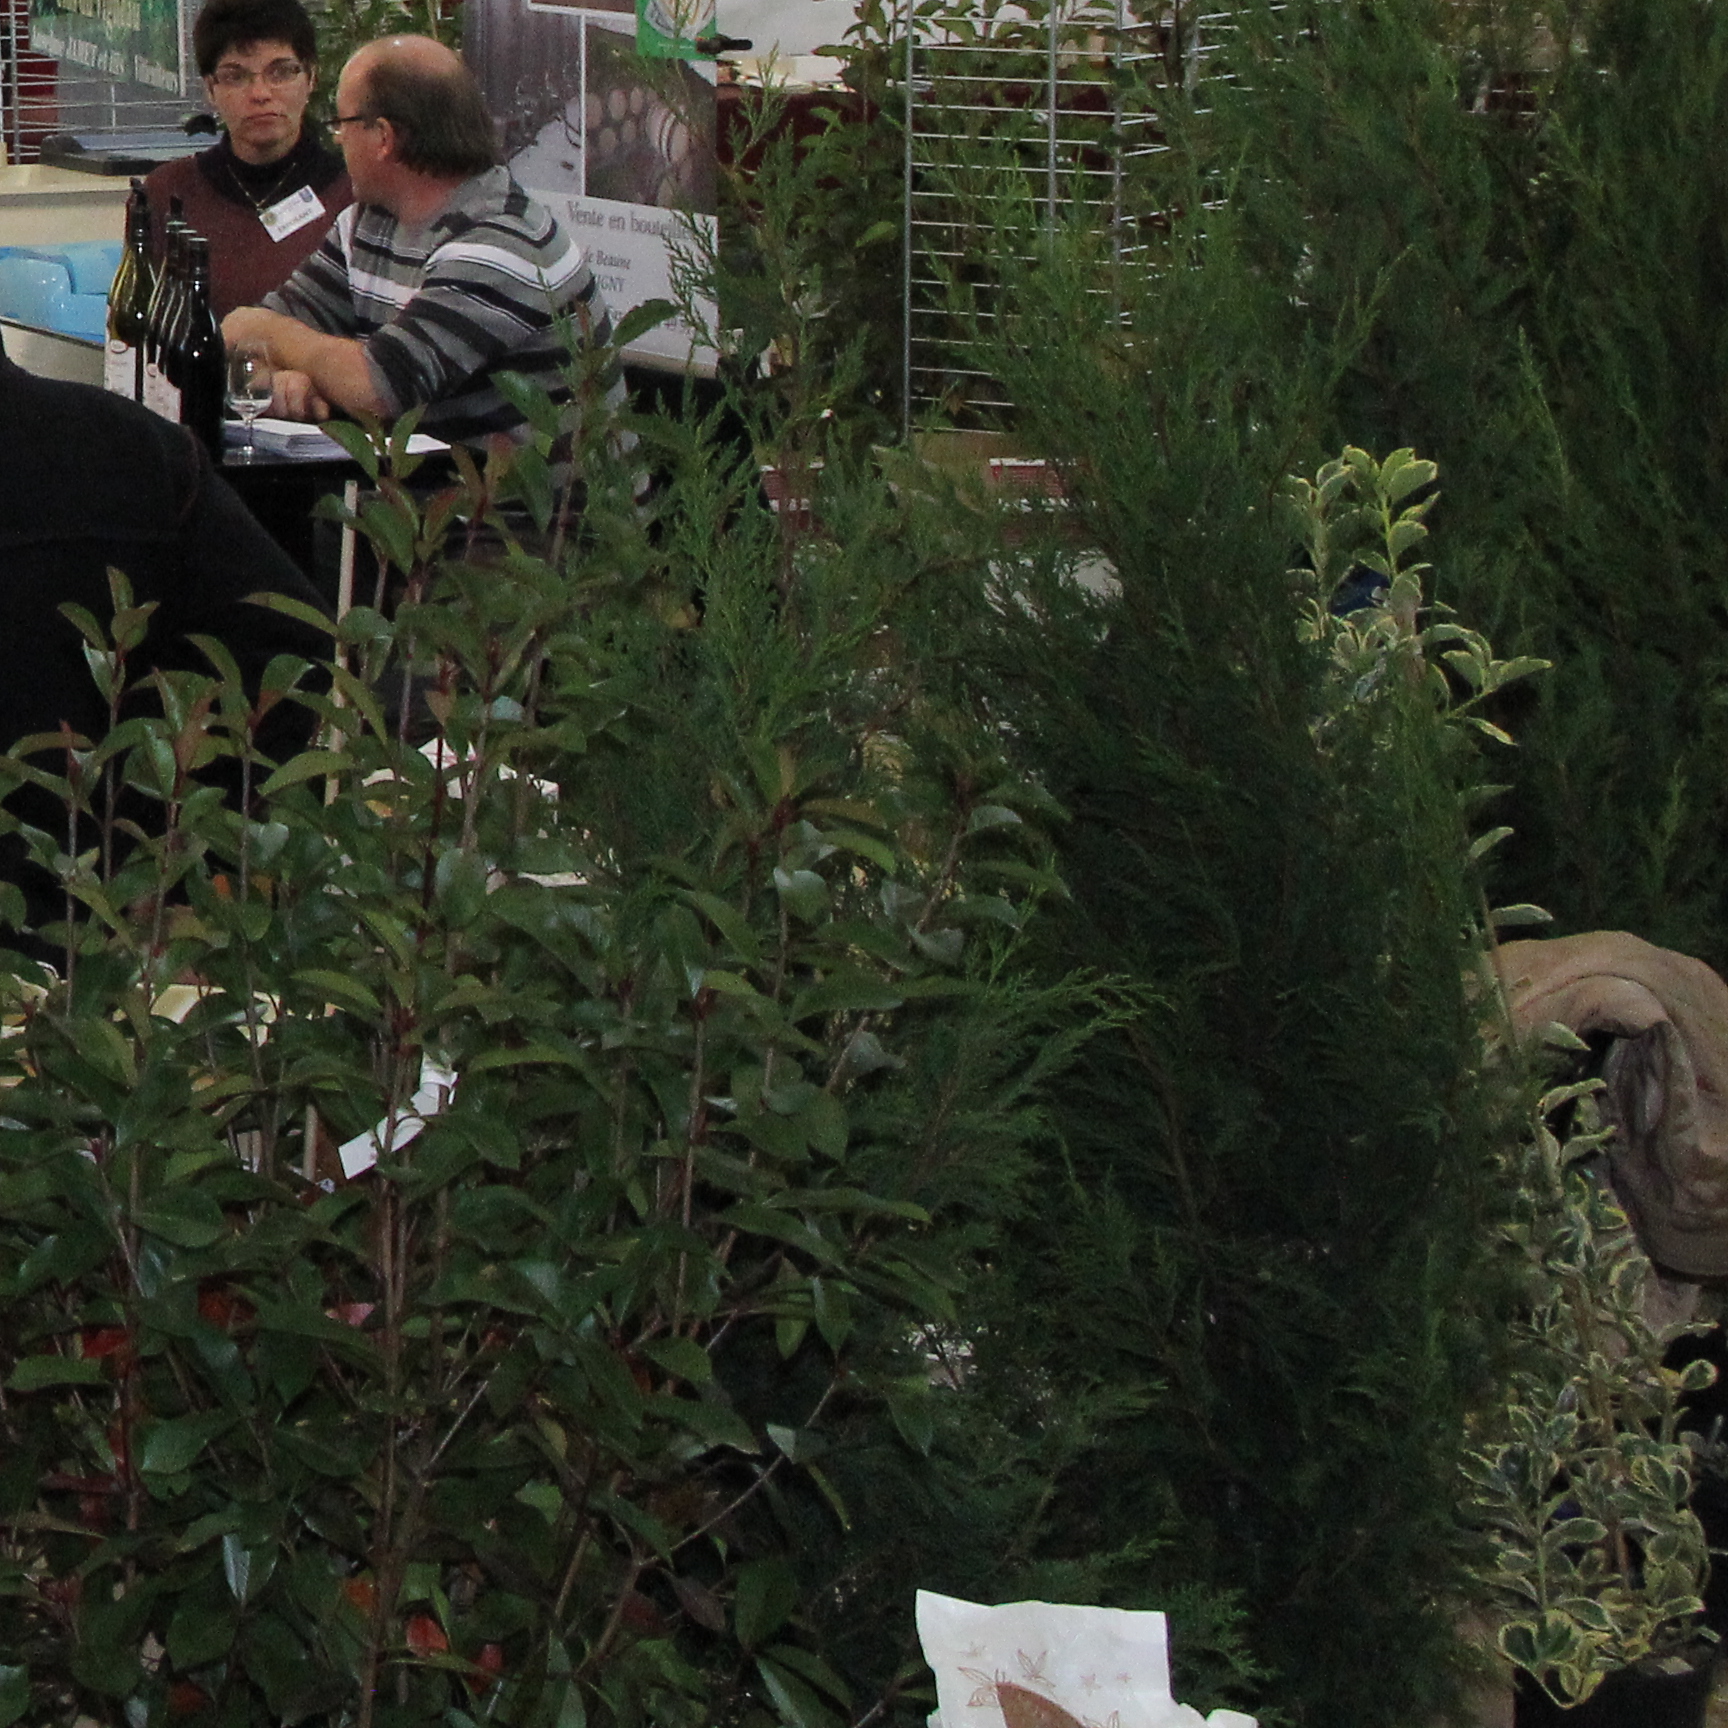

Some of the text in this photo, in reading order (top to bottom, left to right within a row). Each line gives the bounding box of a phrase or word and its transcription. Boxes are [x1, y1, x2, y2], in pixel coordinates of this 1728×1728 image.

[568, 200, 693, 240] Vente en bouteille
